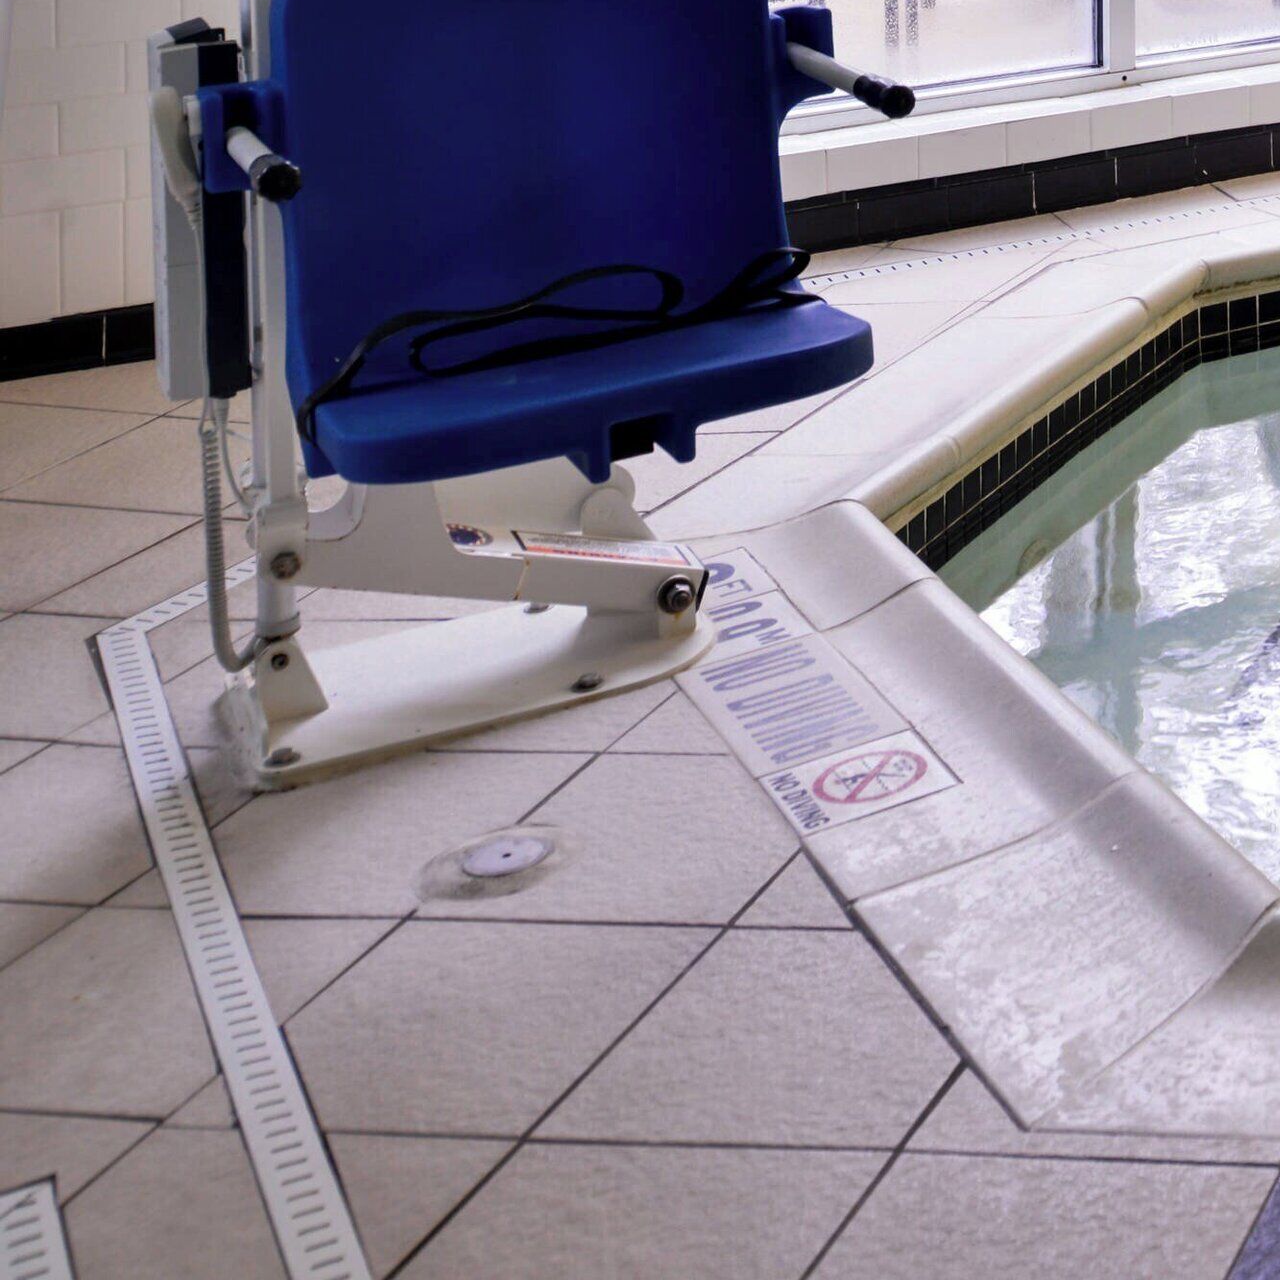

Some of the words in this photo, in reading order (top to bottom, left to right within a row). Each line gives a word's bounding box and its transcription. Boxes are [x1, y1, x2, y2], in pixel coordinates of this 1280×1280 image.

[700, 643, 816, 692] NO
[726, 673, 879, 765] DIVING
[768, 772, 800, 792] NO
[782, 788, 831, 830] DIVING
